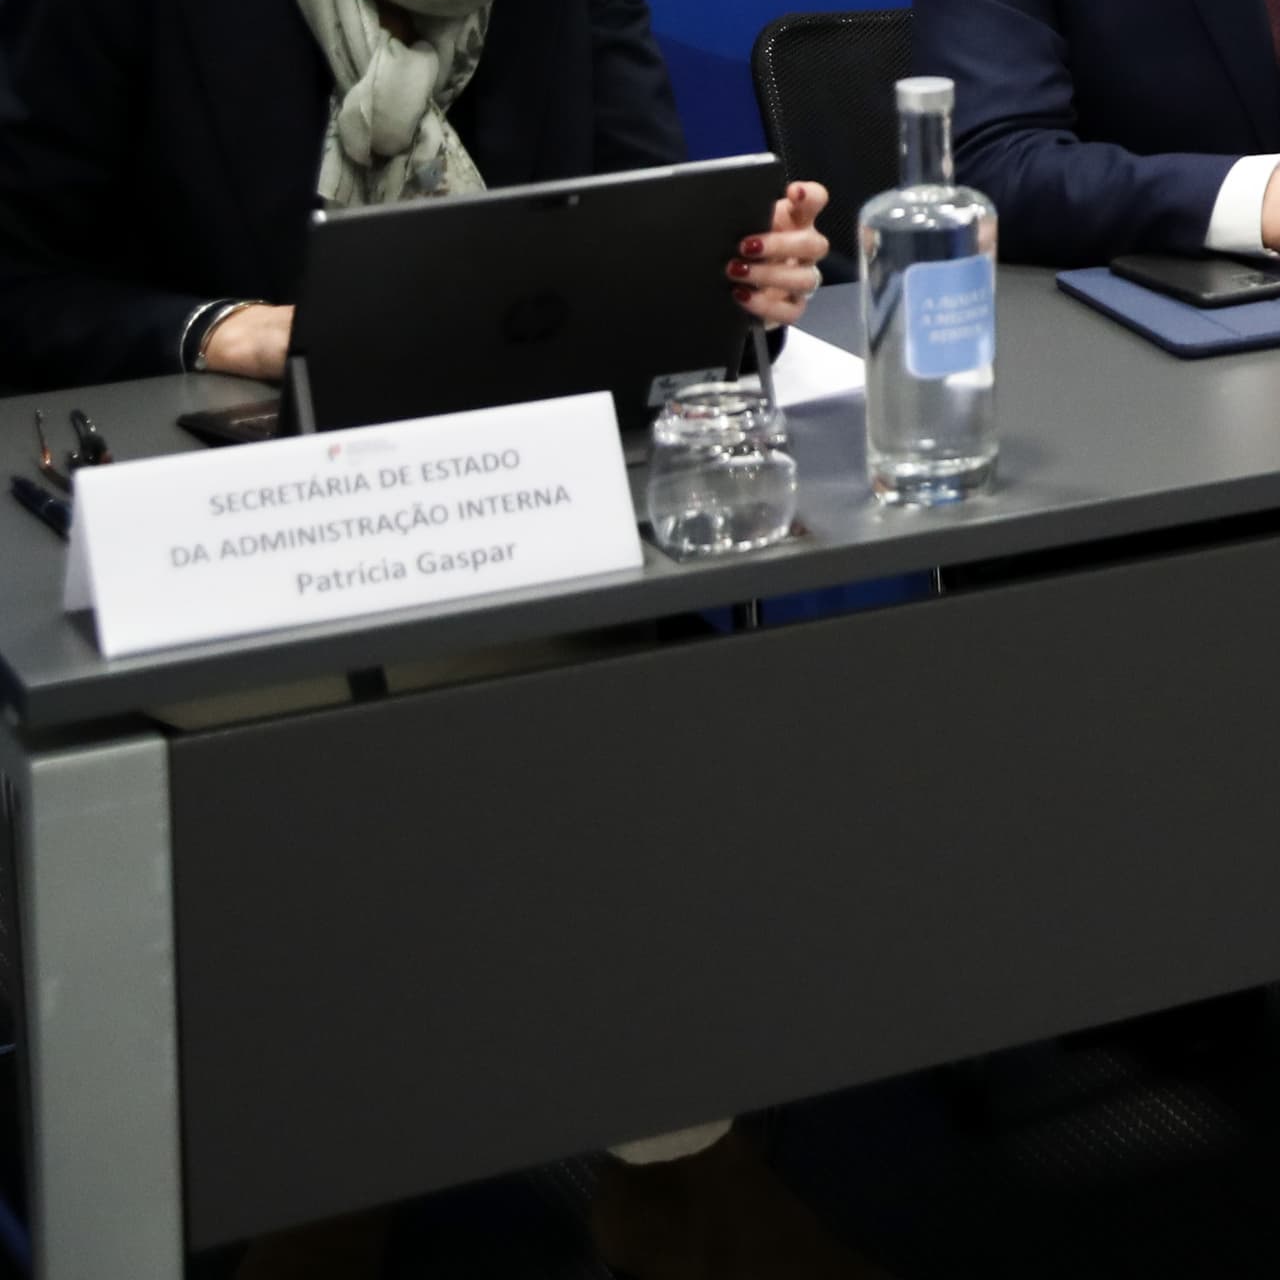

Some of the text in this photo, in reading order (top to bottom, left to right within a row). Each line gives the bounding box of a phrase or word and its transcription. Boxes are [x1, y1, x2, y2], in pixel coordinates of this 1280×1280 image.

[209, 470, 370, 517] SECRETÁRIA
[379, 461, 412, 491] DE
[421, 448, 521, 484] ESTADO
[170, 483, 571, 569] DA ADMINISTRAÇÃO INTERNA
[296, 541, 516, 595] Patrícia Gaspar
